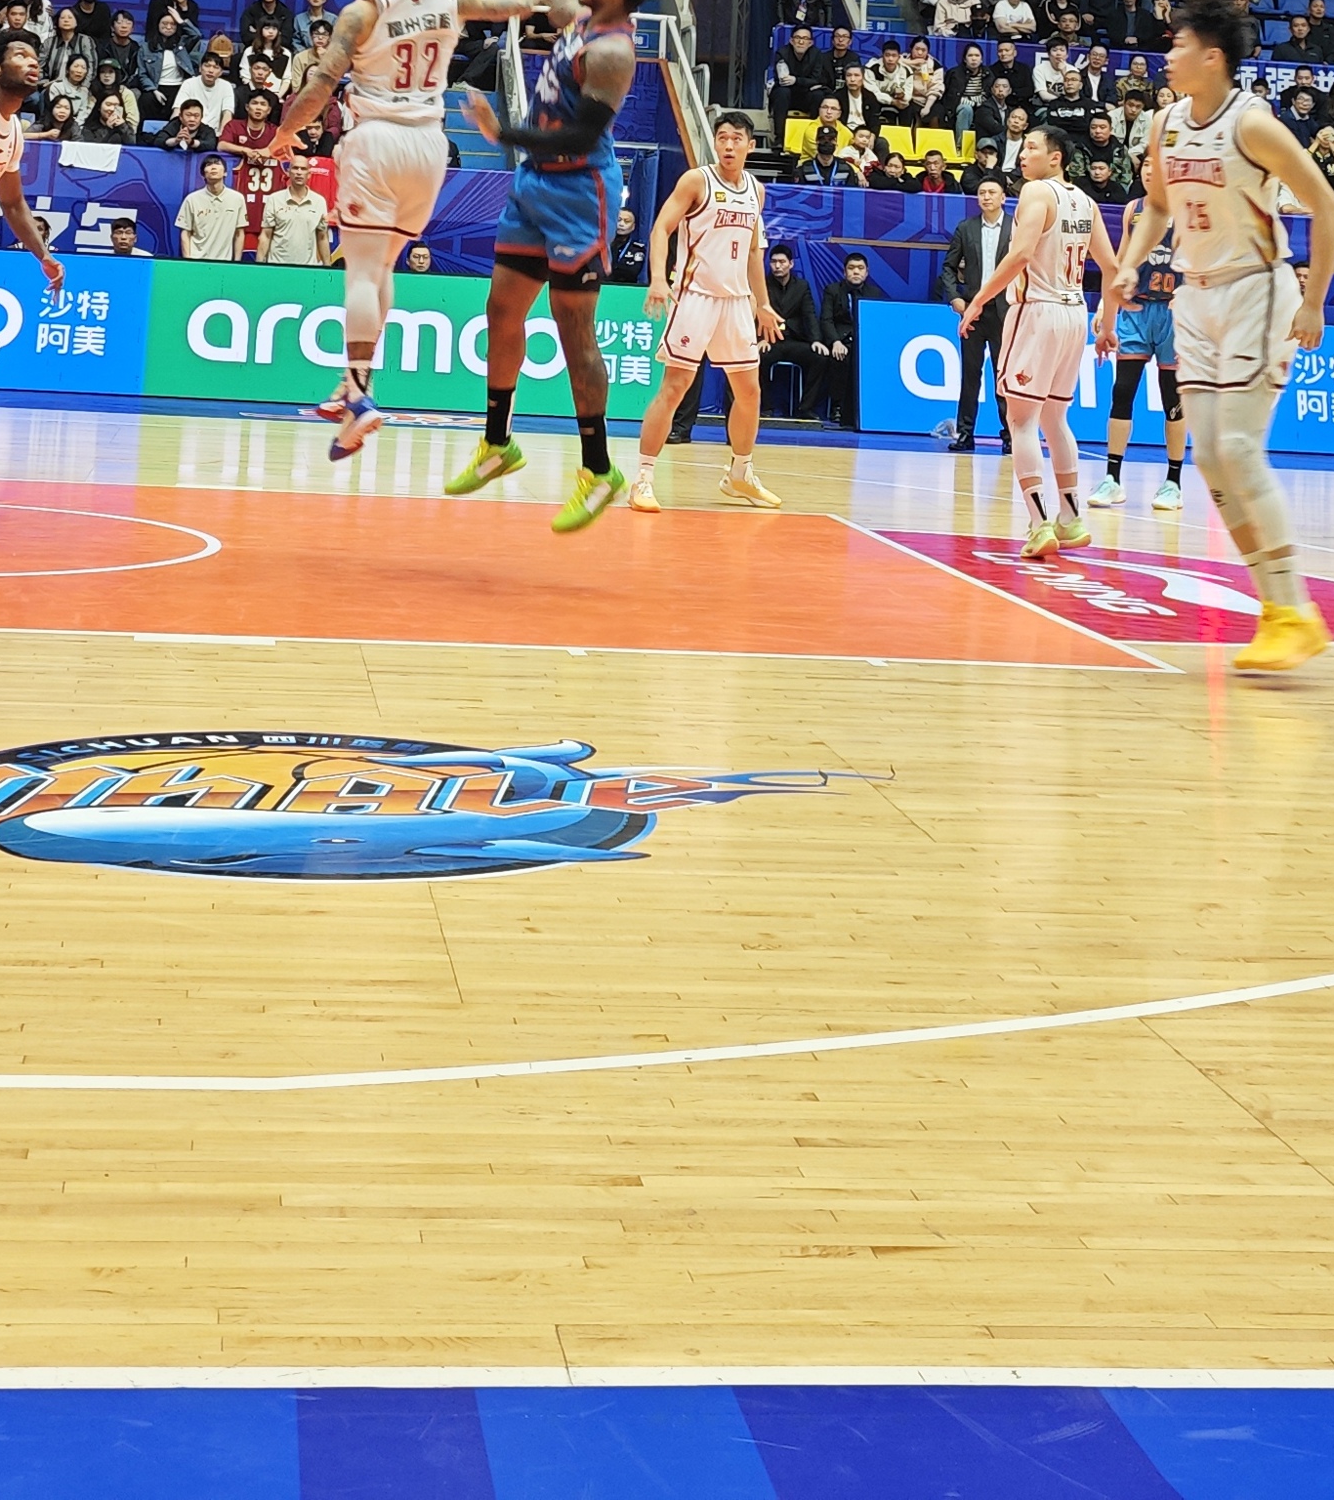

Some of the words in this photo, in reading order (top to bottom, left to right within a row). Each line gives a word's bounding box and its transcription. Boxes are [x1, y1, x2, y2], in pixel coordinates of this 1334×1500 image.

[394, 41, 440, 93] 32
[248, 167, 273, 193] 33
[731, 241, 738, 260] 8
[1149, 271, 1175, 293] 20
[38, 288, 110, 321] 沙特
[36, 323, 106, 357] 阿美
[15, 733, 240, 762] SICHUAN
